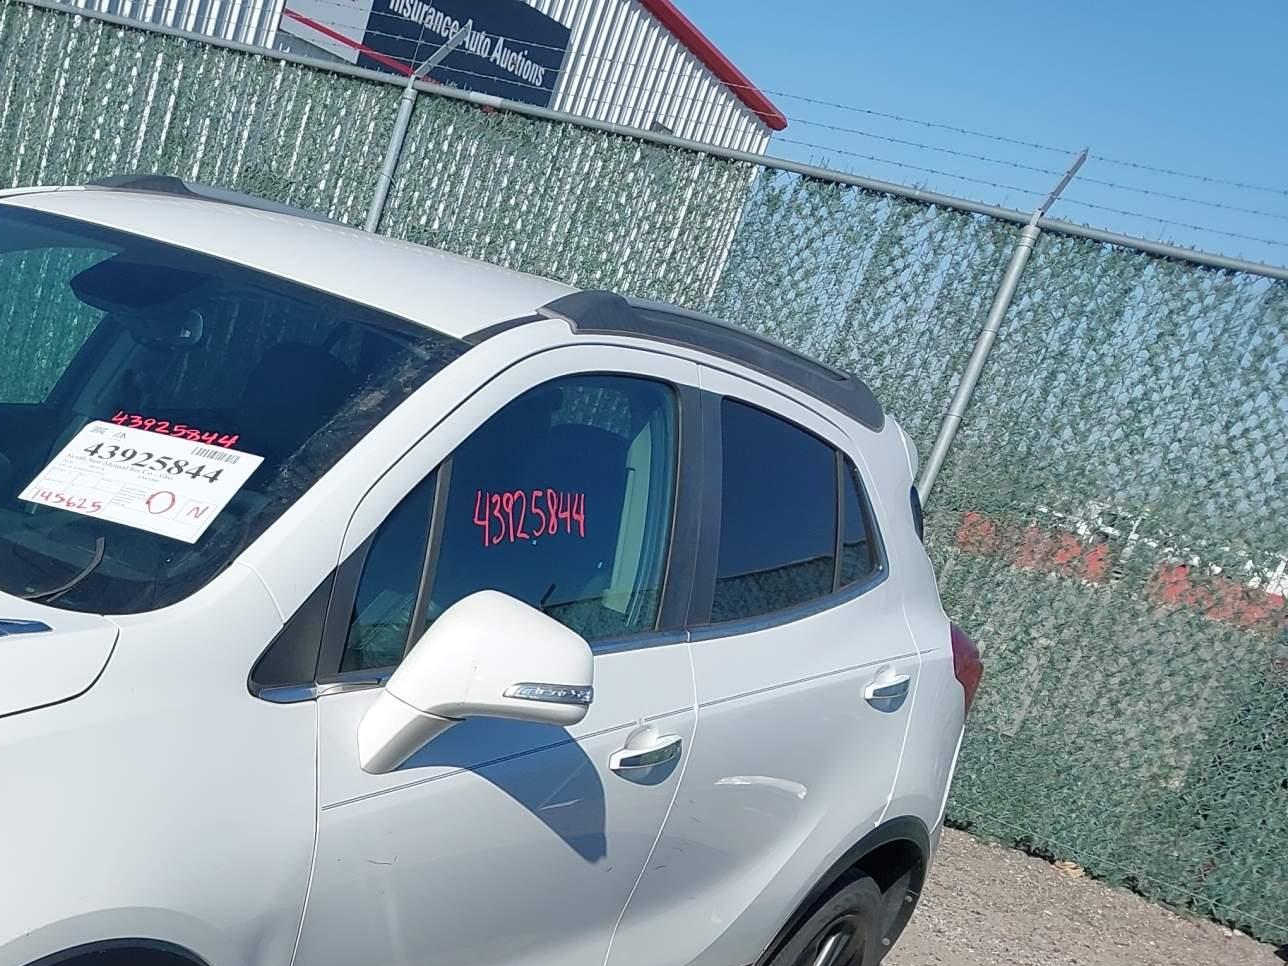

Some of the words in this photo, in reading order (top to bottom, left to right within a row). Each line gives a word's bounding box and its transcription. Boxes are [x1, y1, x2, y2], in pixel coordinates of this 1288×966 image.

[460, 18, 492, 58] Auto
[490, 36, 546, 87] Auctions
[112, 410, 240, 447] 43925844
[84, 442, 225, 484] 43925844
[473, 488, 585, 547] 43925844
